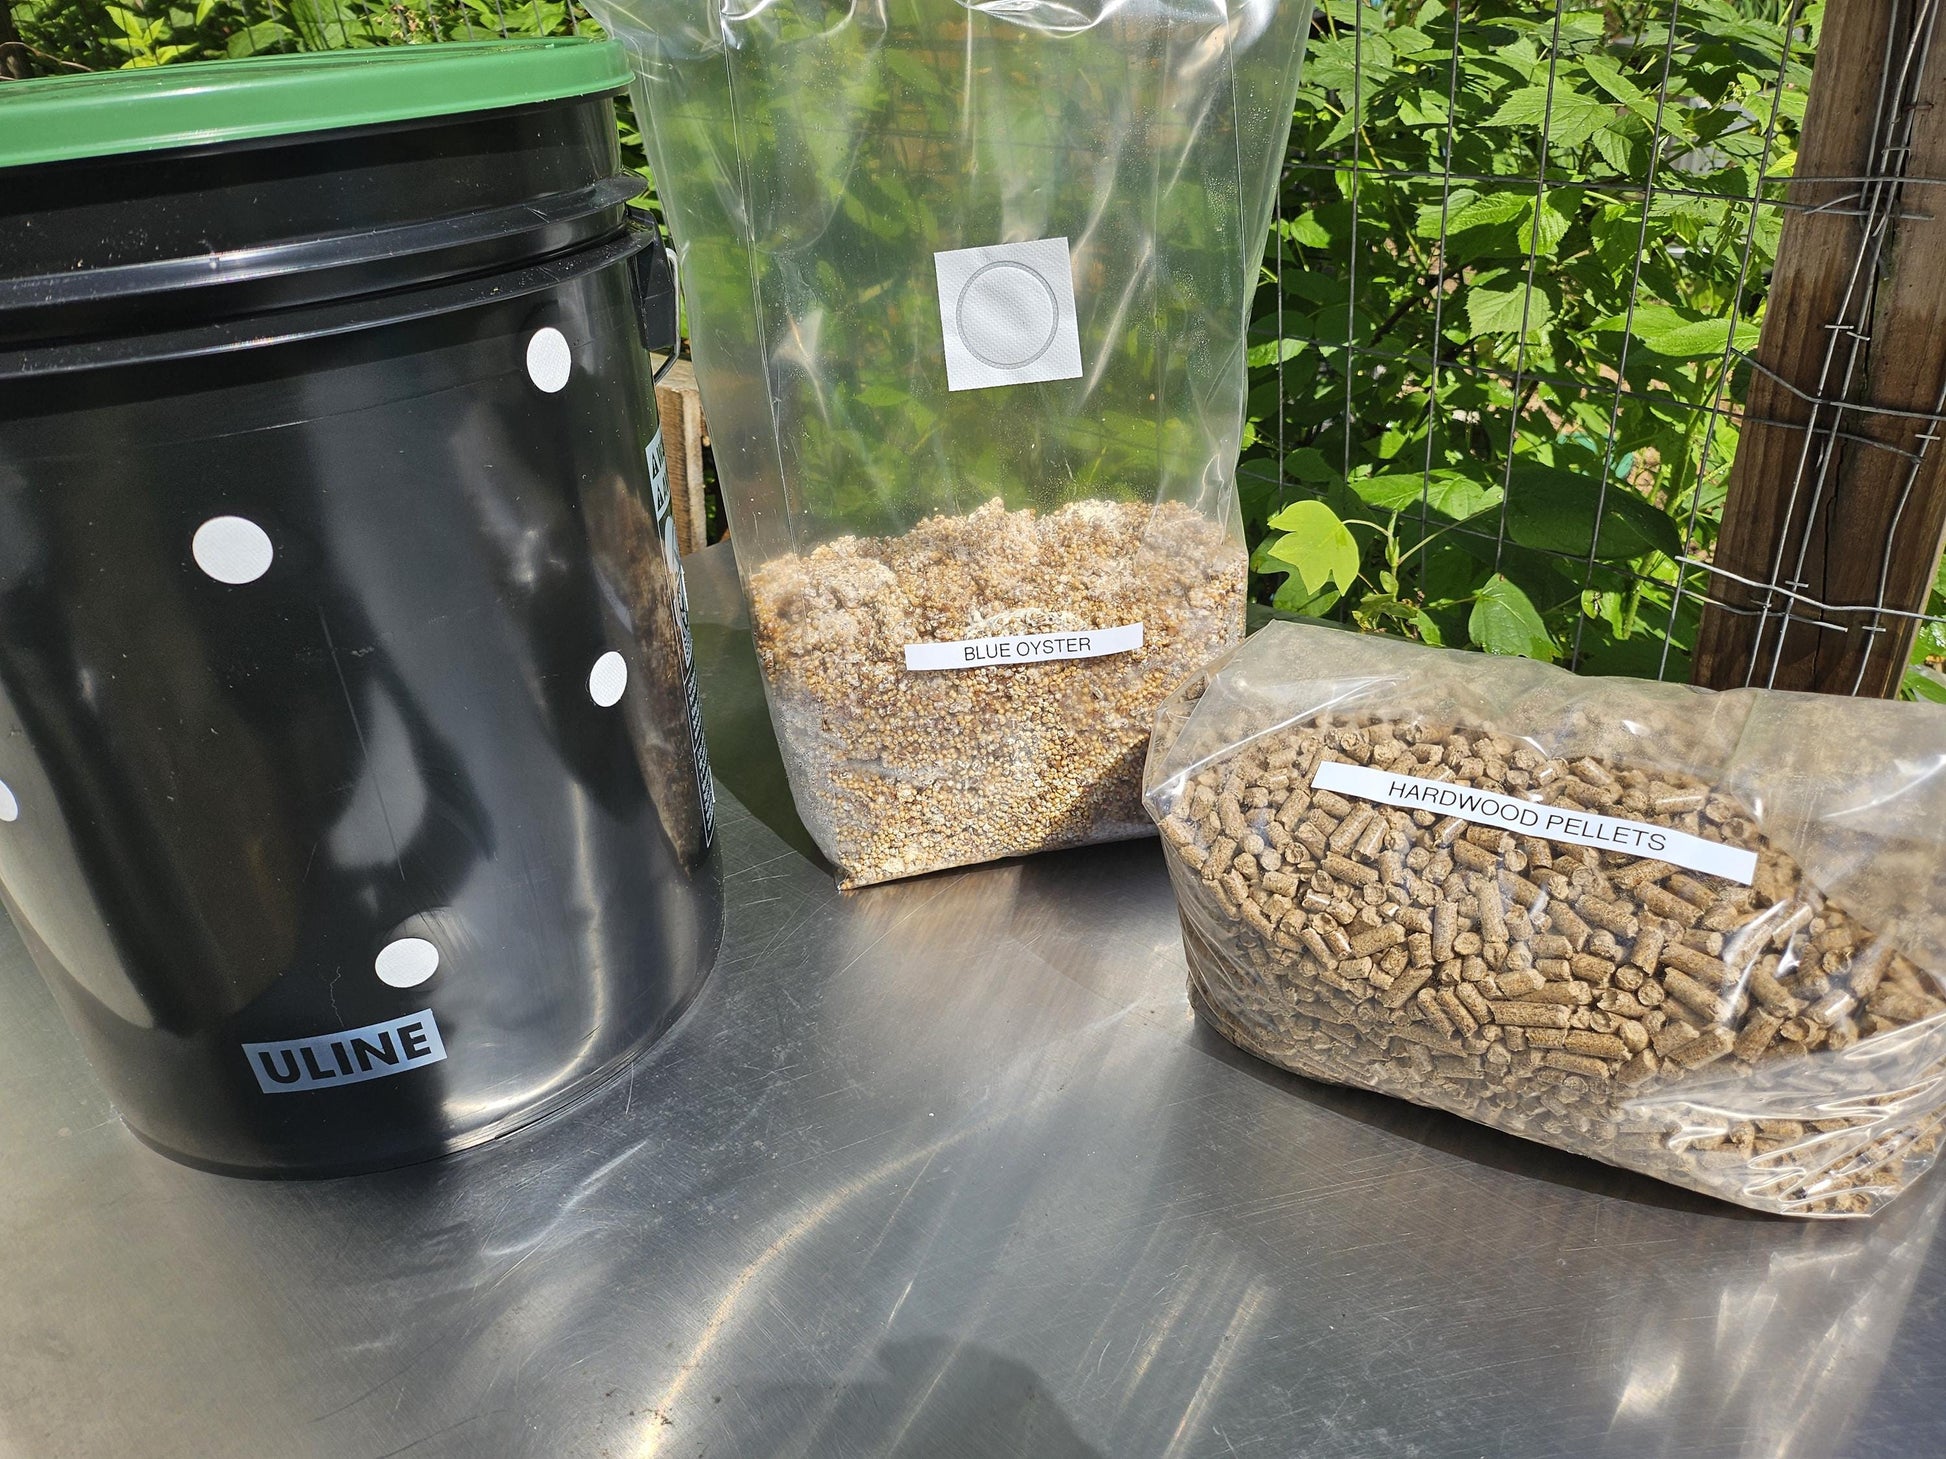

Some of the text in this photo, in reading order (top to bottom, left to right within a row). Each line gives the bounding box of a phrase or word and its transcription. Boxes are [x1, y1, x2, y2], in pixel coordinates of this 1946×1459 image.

[964, 637, 1091, 661] BLUE OYSTER
[1388, 780, 1668, 852] HARDWOOD PELLETS
[258, 1021, 432, 1085] ULINE
